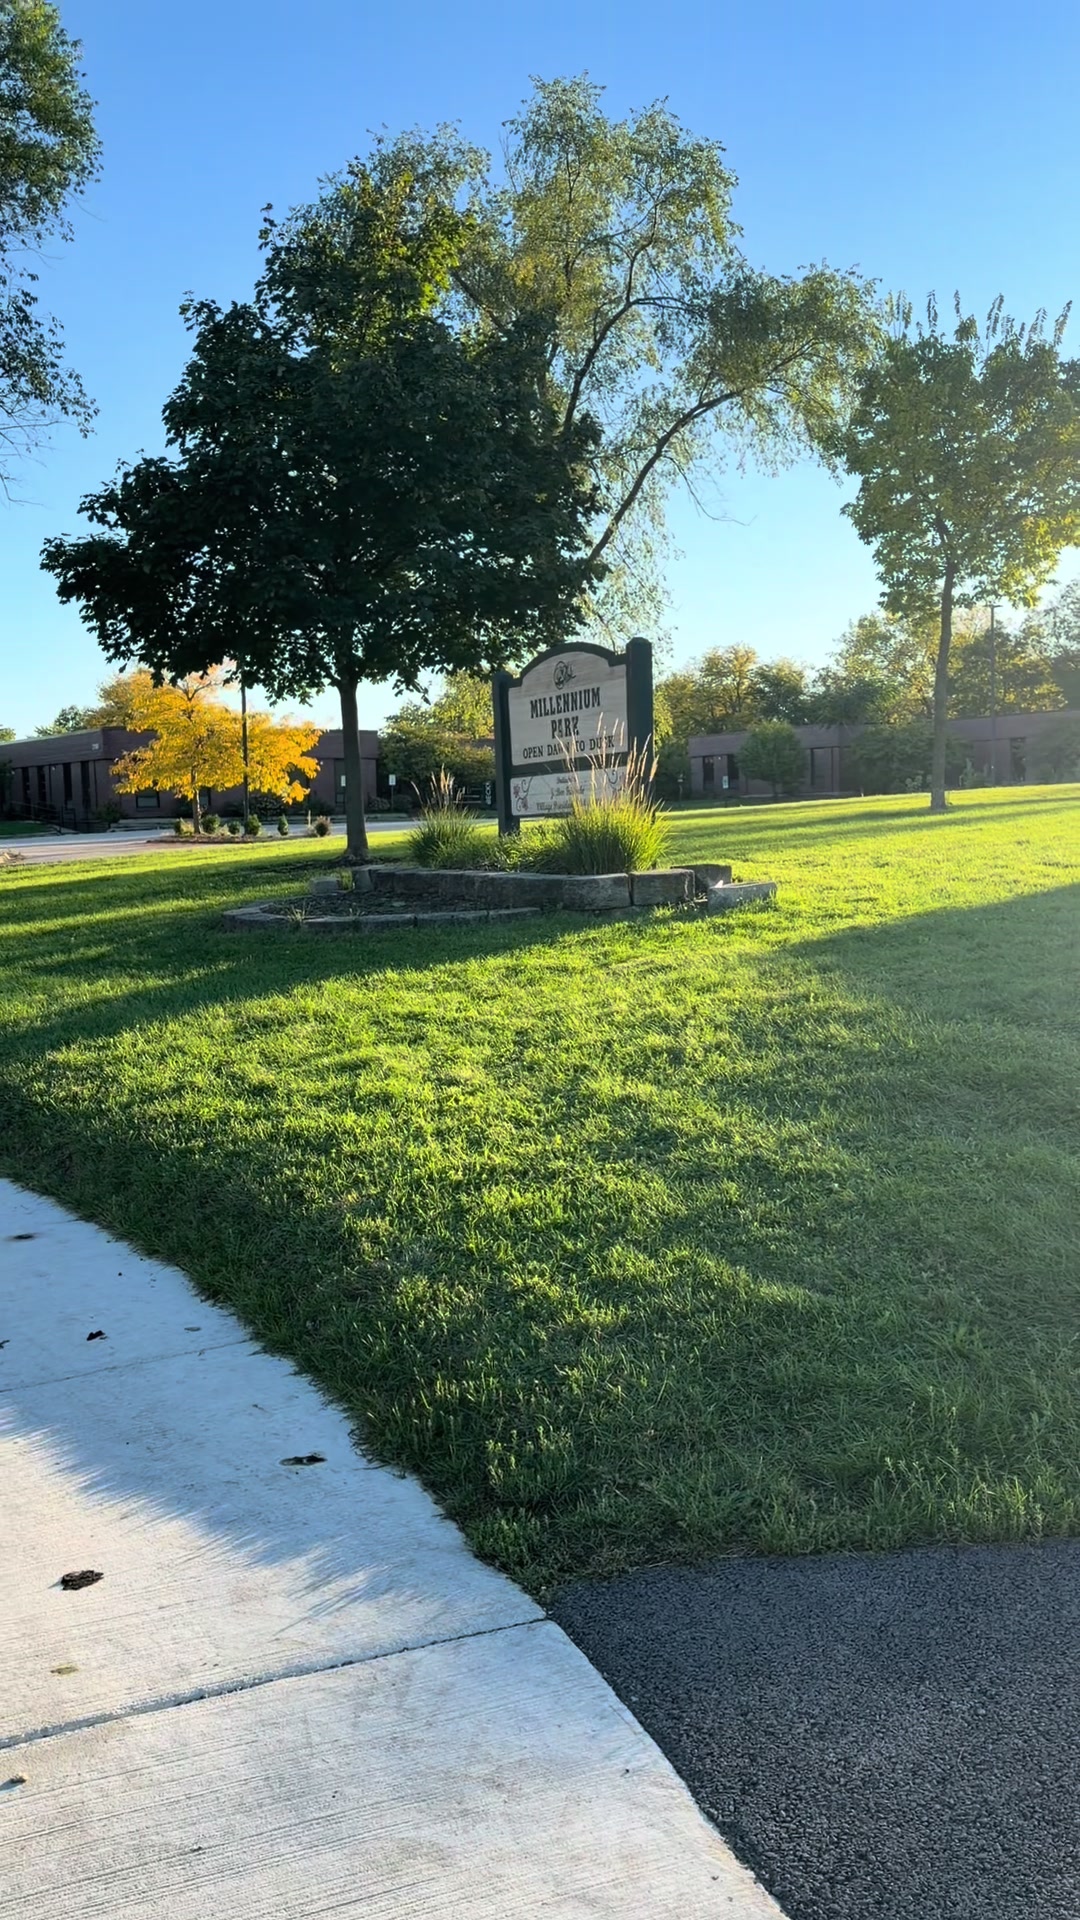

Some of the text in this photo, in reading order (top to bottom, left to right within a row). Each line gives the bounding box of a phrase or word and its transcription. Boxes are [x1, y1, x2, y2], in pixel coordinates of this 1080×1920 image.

[530, 687, 601, 719] MILLENNIUM
[551, 715, 580, 739] PARK
[522, 745, 544, 759] OPEN
[574, 740, 586, 753] TO
